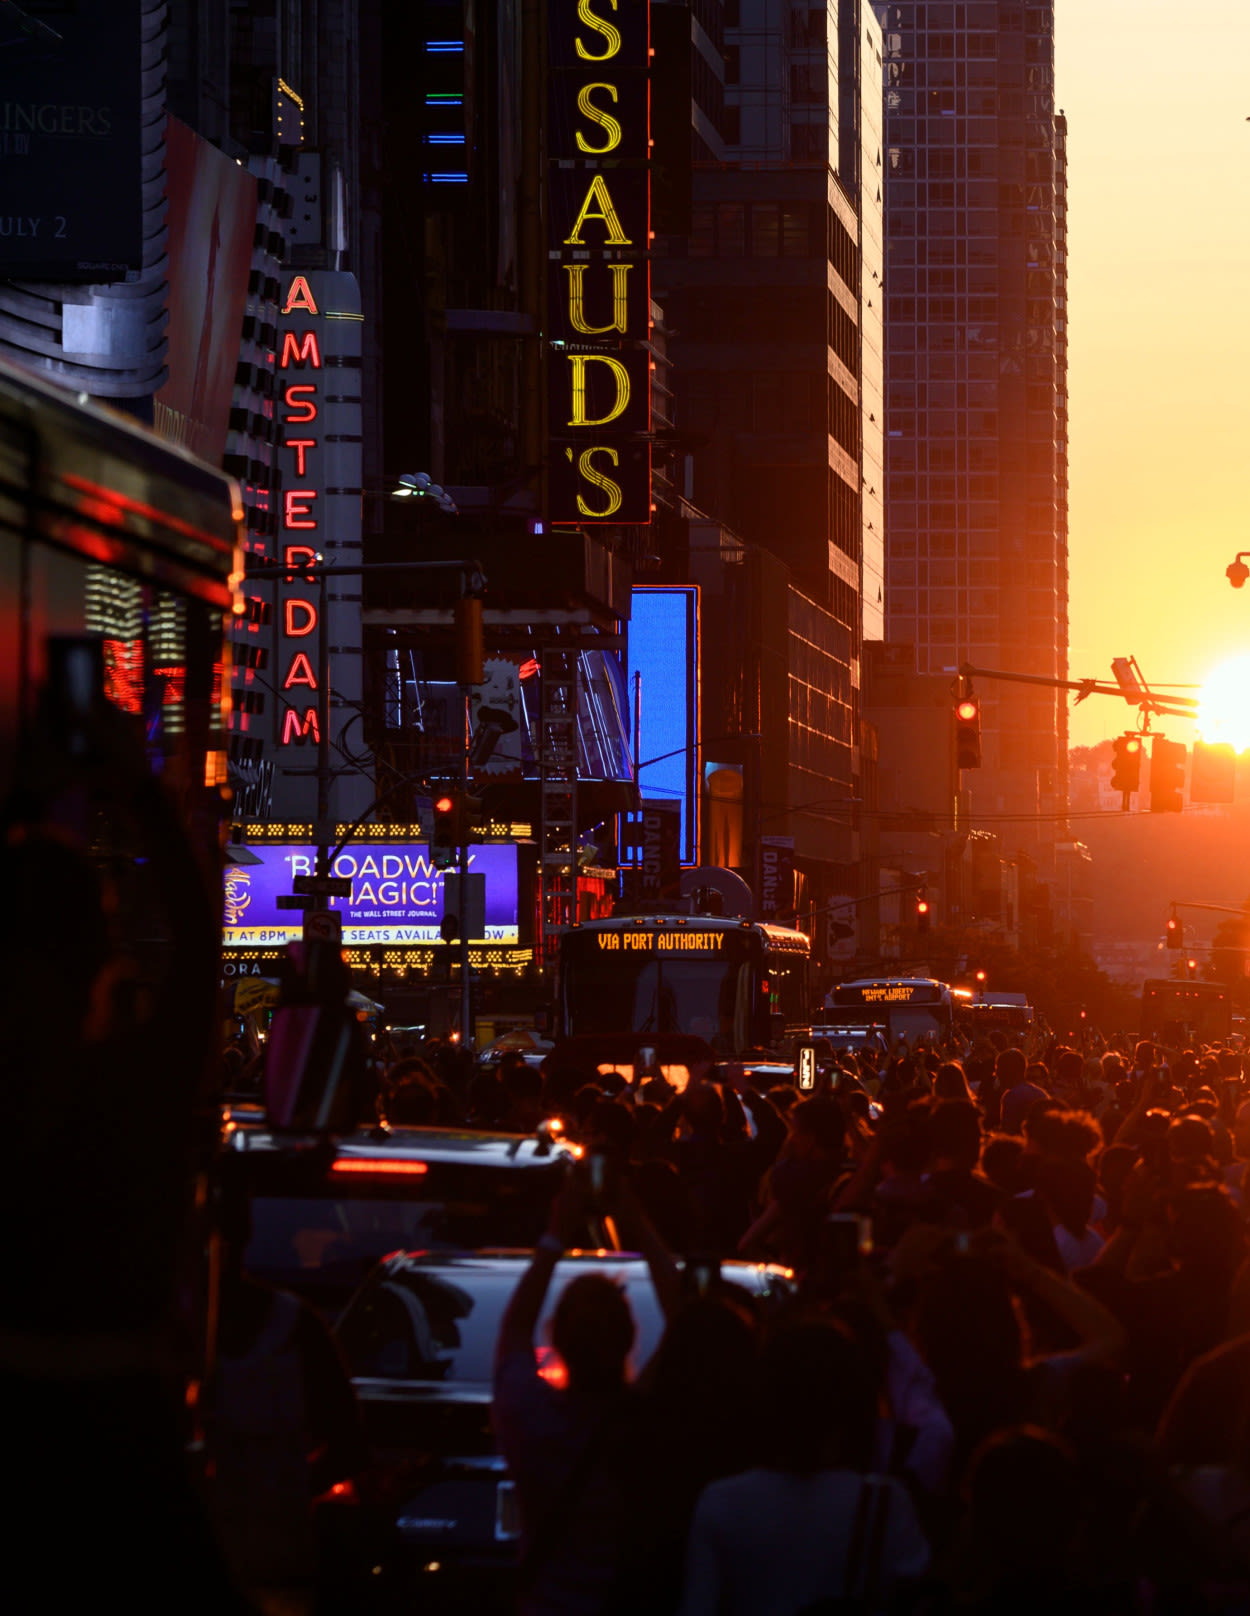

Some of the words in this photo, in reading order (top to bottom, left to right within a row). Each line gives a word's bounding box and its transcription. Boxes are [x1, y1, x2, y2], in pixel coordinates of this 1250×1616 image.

[54, 216, 68, 238] 2
[281, 276, 320, 745] AMSTERDAM
[643, 816, 661, 890] DANCE
[763, 851, 778, 911] DANCE
[240, 932, 255, 941] AT
[260, 931, 286, 941] 8PM
[351, 931, 390, 940] SEATS
[598, 933, 619, 950] VIA
[624, 933, 654, 950] PORT
[658, 933, 724, 950] AUTHORITY
[889, 987, 914, 995] LIBERTY
